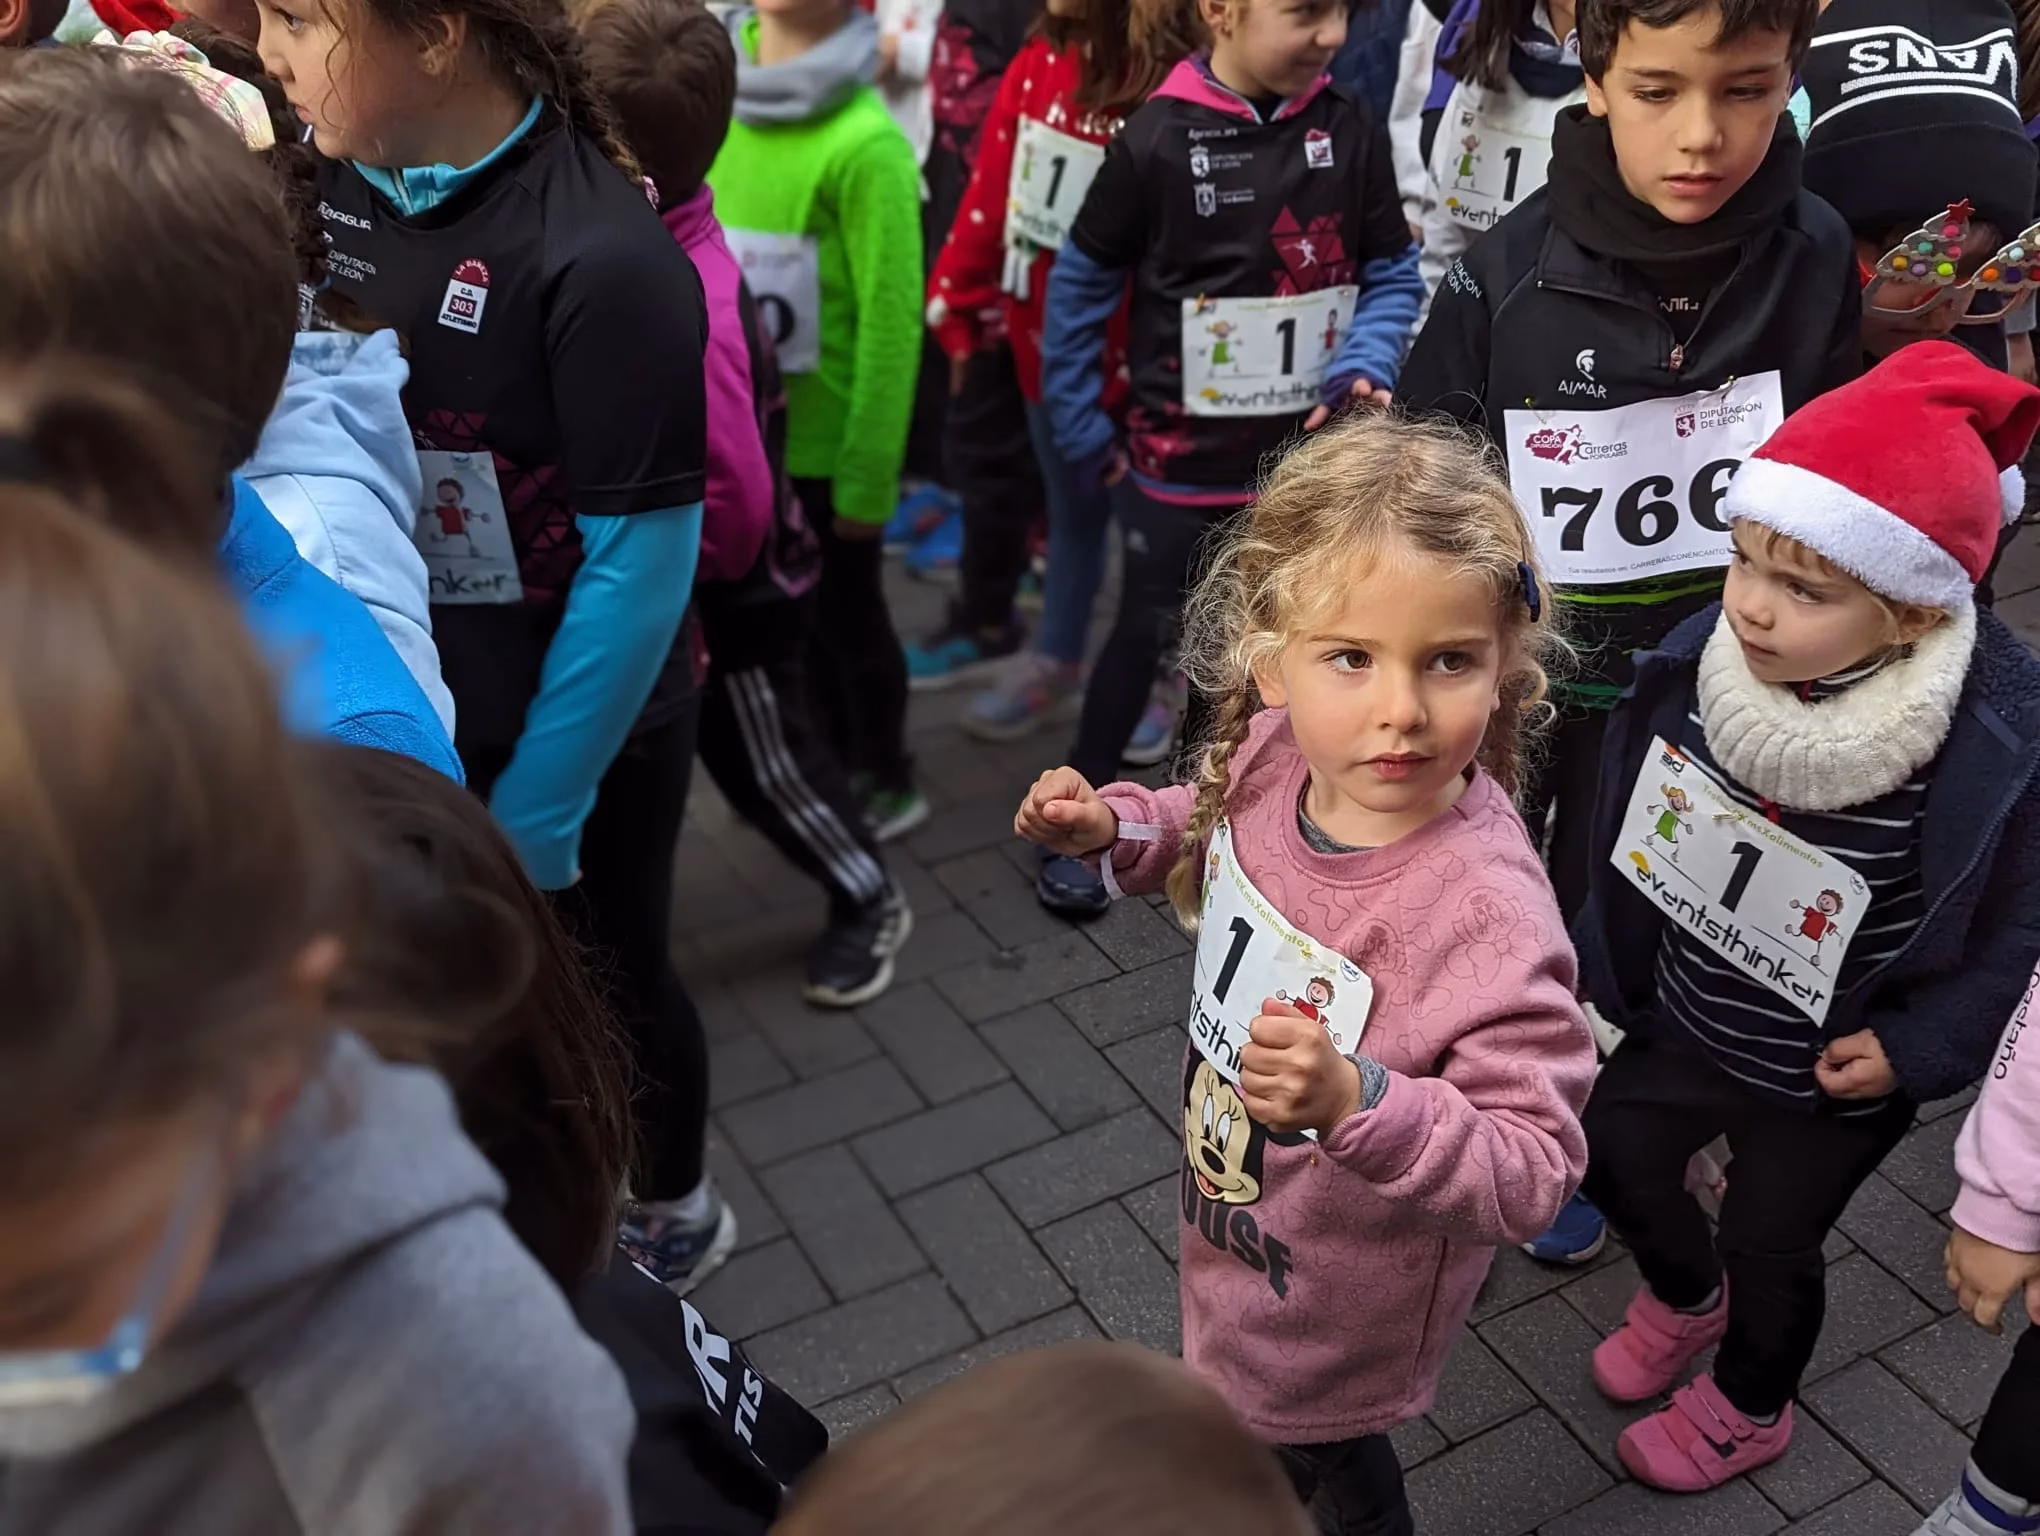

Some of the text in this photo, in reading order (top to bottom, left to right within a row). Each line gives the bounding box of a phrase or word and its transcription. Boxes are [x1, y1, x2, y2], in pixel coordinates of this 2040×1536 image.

[1841, 37, 2018, 101] VANS
[1044, 154, 1067, 209] 1
[1502, 146, 1523, 203] 1
[451, 298, 474, 315] 303
[1275, 317, 1297, 376] 1
[1557, 379, 1608, 400] AIMAR
[1533, 435, 1562, 444] COPA
[1576, 441, 1628, 460] Carreras
[1700, 419, 1715, 430] DE
[1719, 841, 1764, 914] 1
[1212, 916, 1255, 1006] 1
[1636, 866, 1825, 1006] eventsthinker
